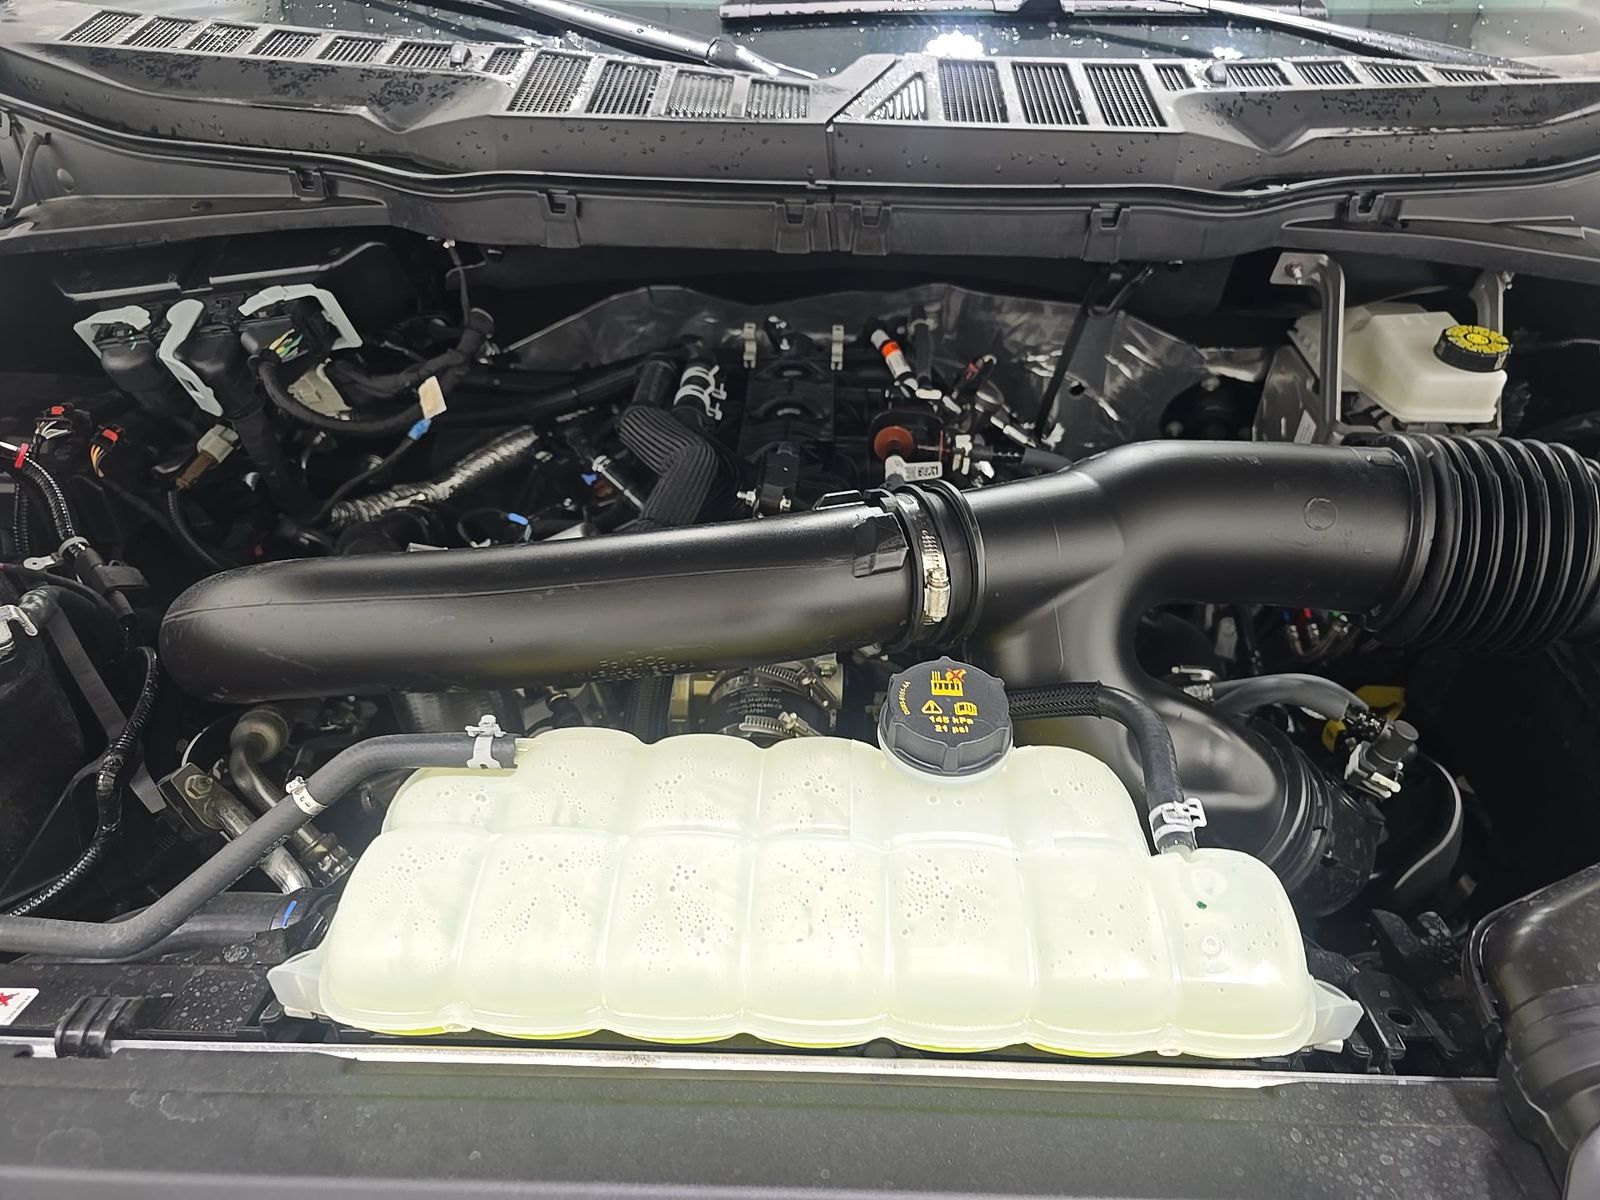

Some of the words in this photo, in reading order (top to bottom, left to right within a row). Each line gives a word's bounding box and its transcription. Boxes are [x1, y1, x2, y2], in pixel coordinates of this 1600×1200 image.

[928, 715, 950, 724] 145
[952, 716, 974, 725] kPa
[934, 724, 948, 732] 21
[951, 725, 969, 734] psi
